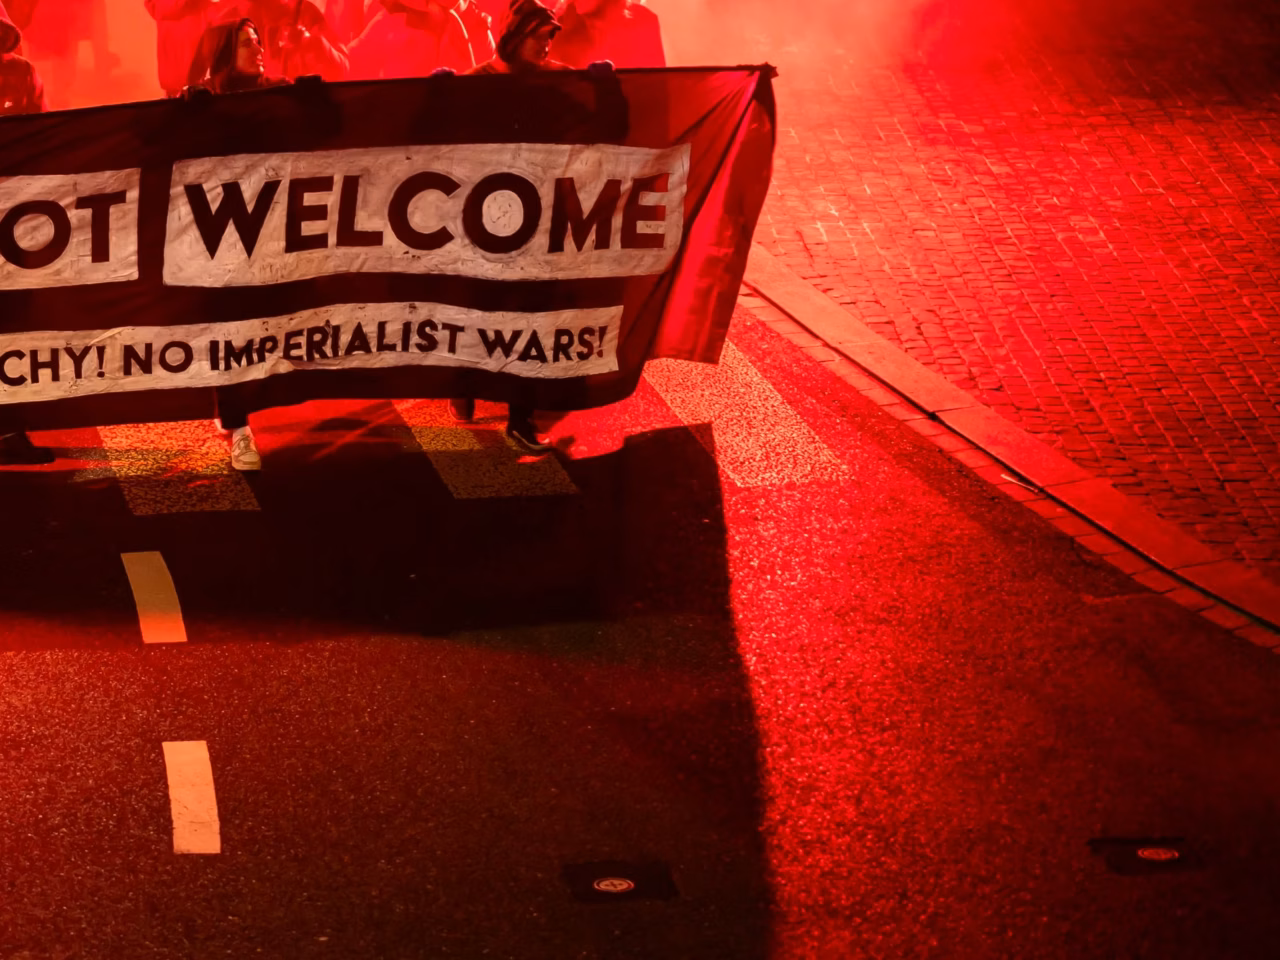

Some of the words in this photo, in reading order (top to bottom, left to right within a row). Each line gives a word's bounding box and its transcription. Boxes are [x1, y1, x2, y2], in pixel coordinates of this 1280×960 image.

[184, 170, 670, 261] WELCOME
[122, 340, 194, 377] NO
[209, 318, 465, 372] IMPERIALIST
[477, 325, 610, 364] WARS!
